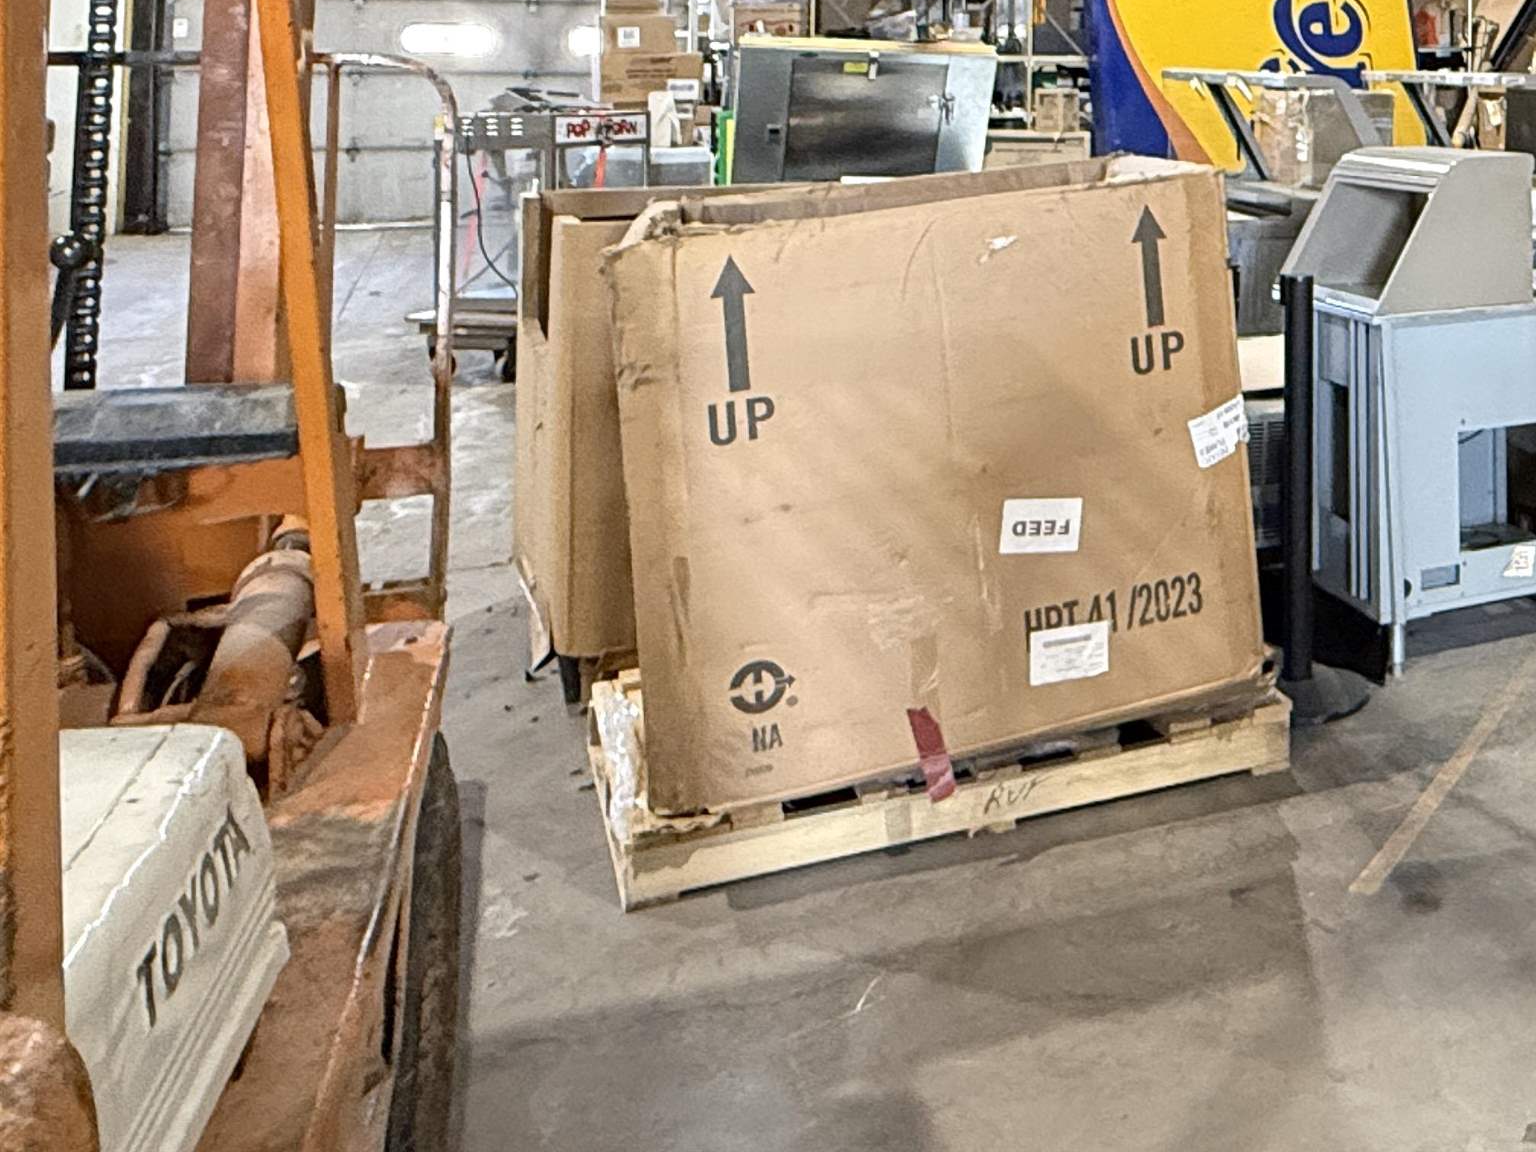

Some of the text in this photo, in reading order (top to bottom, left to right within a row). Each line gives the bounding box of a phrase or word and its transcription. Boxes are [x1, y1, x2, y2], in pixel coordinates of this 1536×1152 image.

[1131, 330, 1184, 375] UP
[708, 396, 775, 446] UP
[1012, 519, 1071, 536] FEED
[137, 805, 251, 1027] TOYOTA
